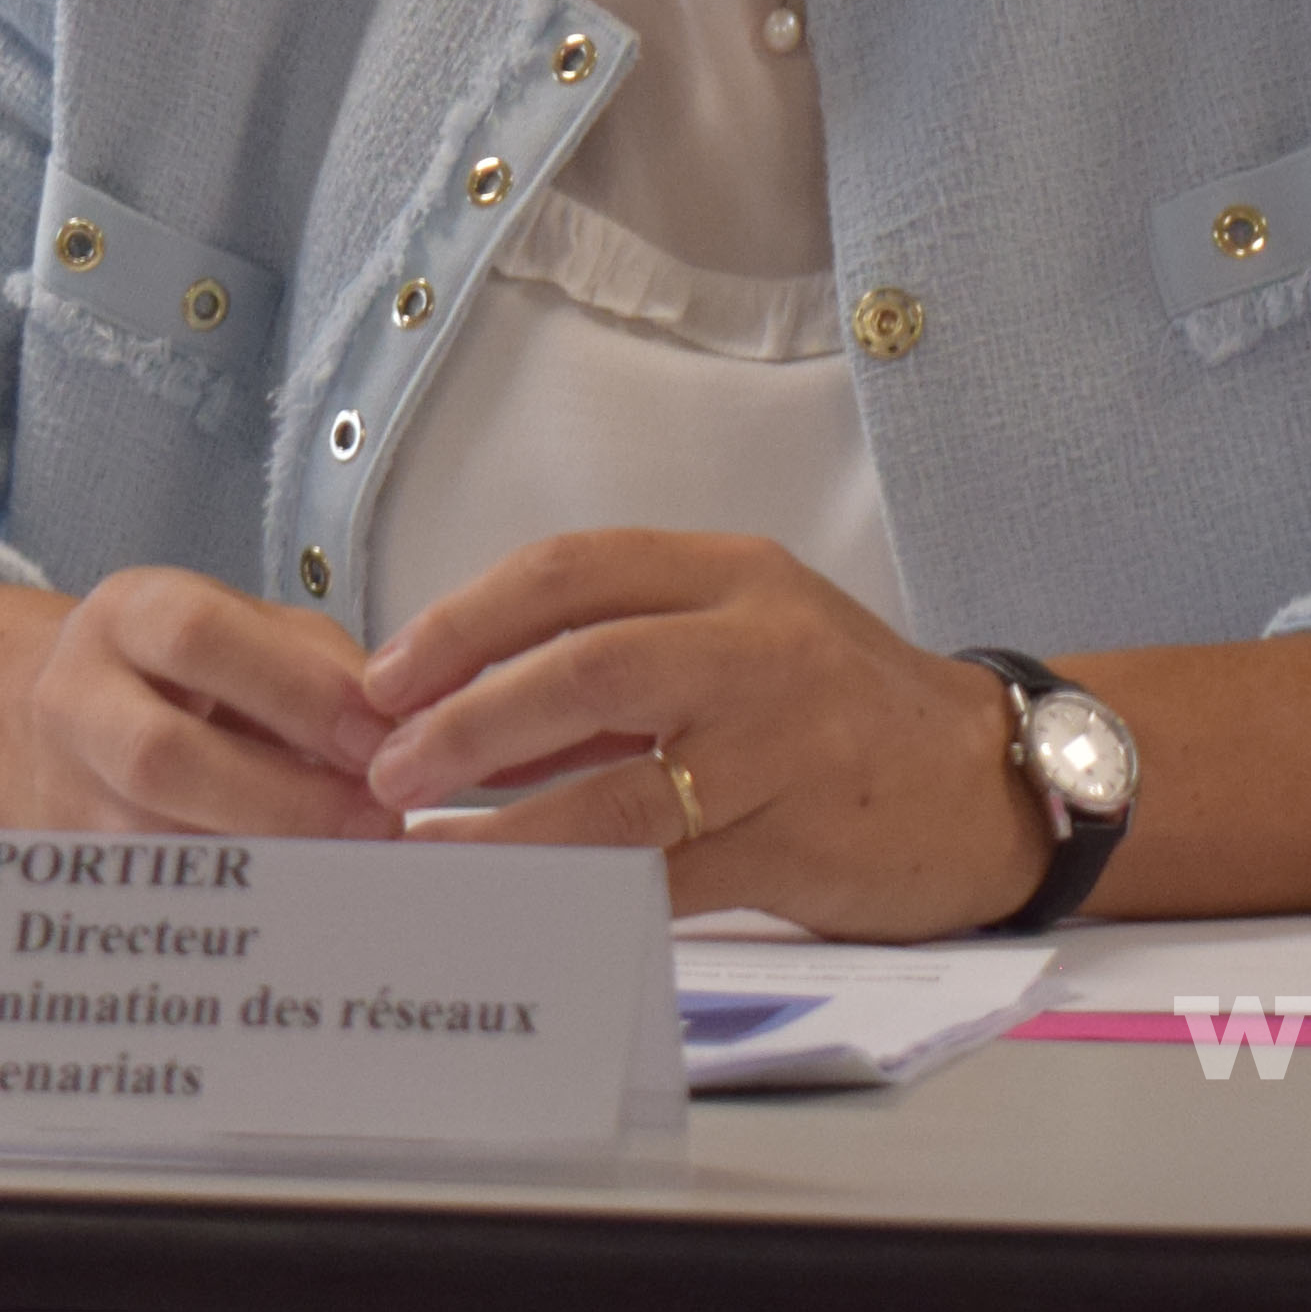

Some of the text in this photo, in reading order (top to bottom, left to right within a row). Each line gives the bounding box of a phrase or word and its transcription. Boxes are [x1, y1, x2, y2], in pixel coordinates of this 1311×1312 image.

[14, 911, 259, 958] Directeur
[239, 984, 322, 1030] des
[339, 986, 538, 1035] réseaux
